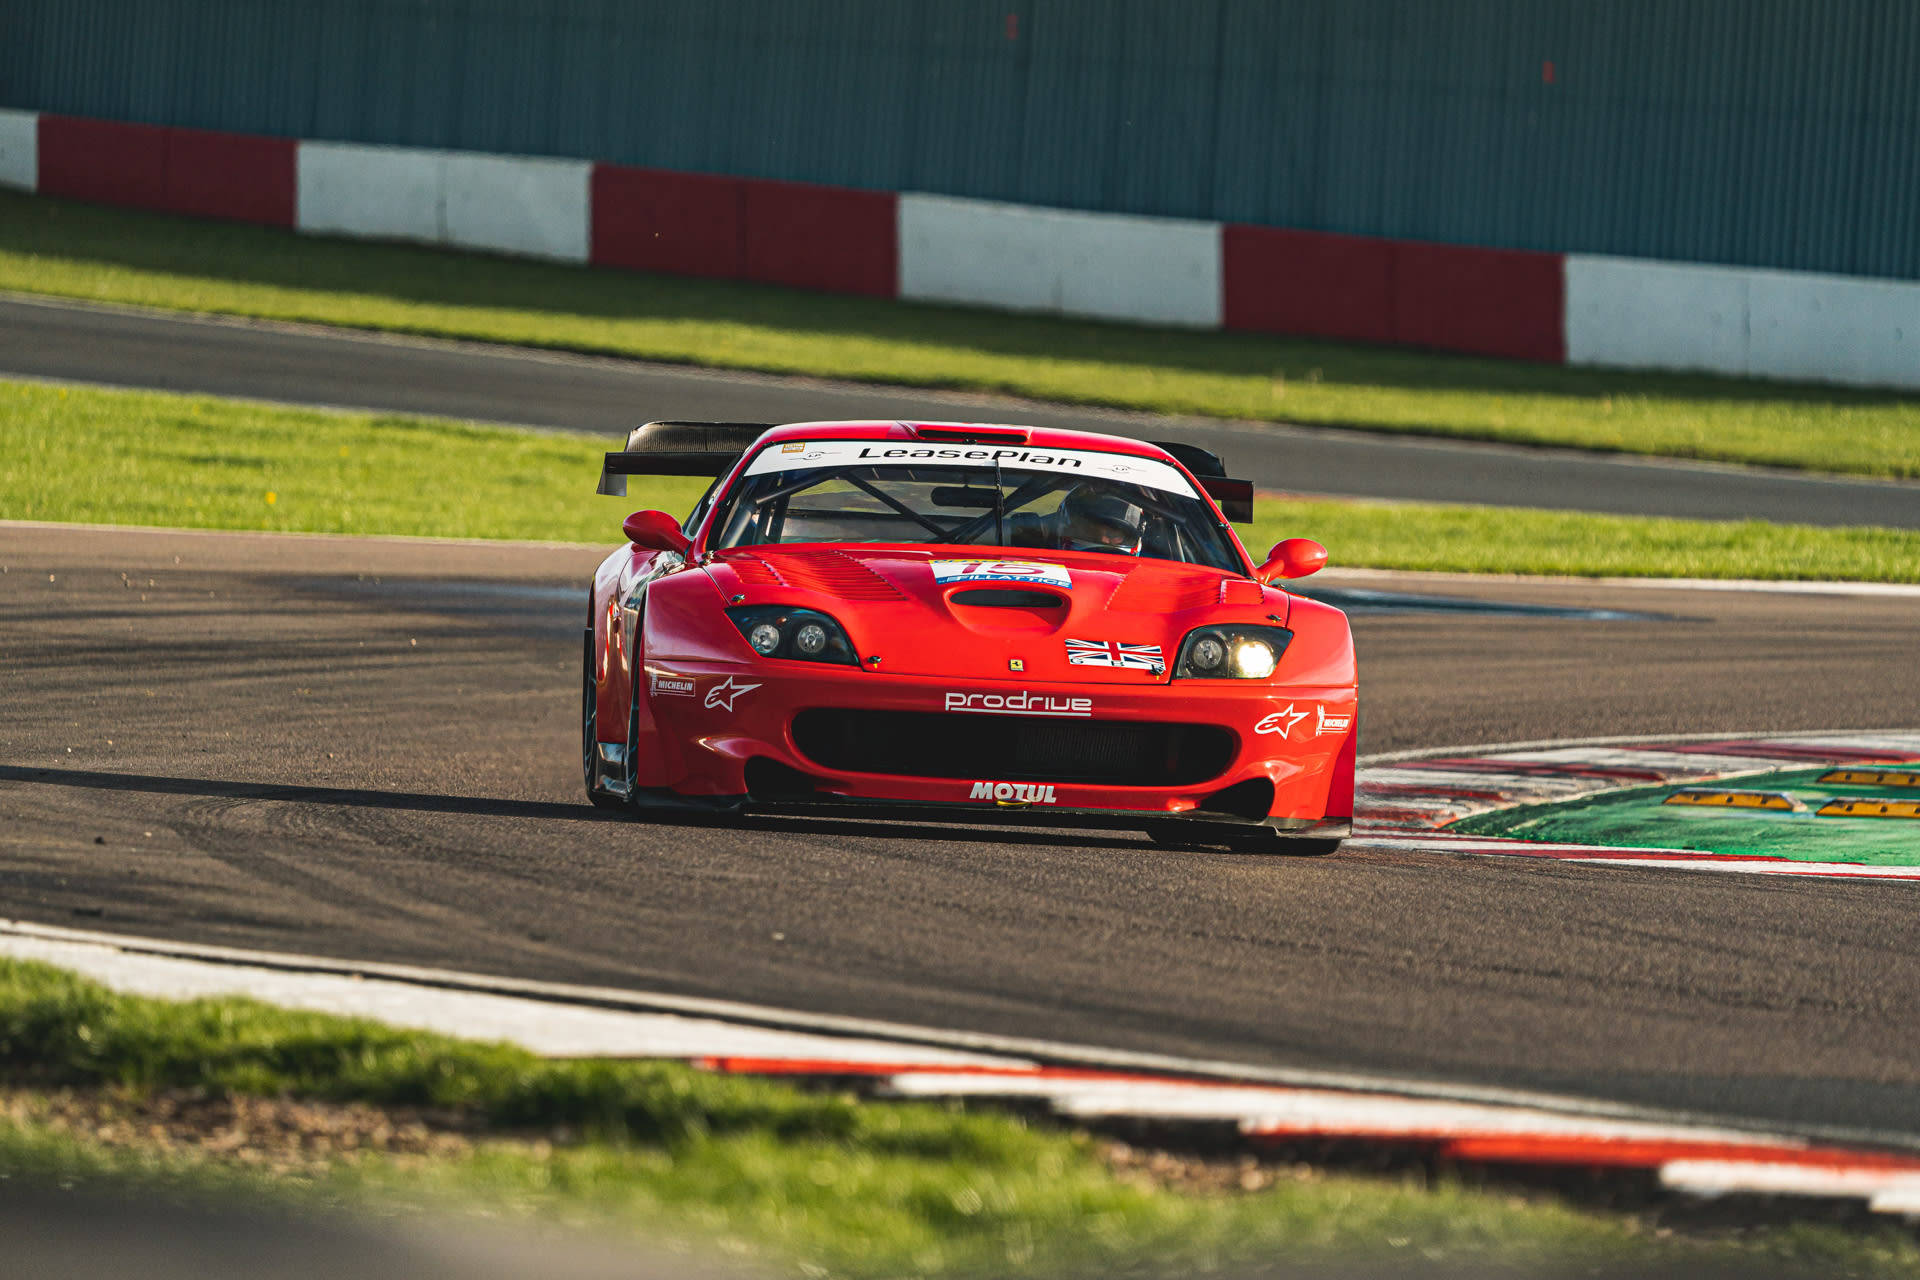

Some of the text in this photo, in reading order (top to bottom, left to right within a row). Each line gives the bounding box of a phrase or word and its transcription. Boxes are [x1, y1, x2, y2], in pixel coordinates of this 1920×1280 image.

[858, 447, 1082, 468] LeasePlan
[960, 562, 1045, 575] 15
[658, 680, 694, 691] MICHELIN
[945, 690, 1092, 711] prodrive
[969, 782, 1057, 803] MOTUL
